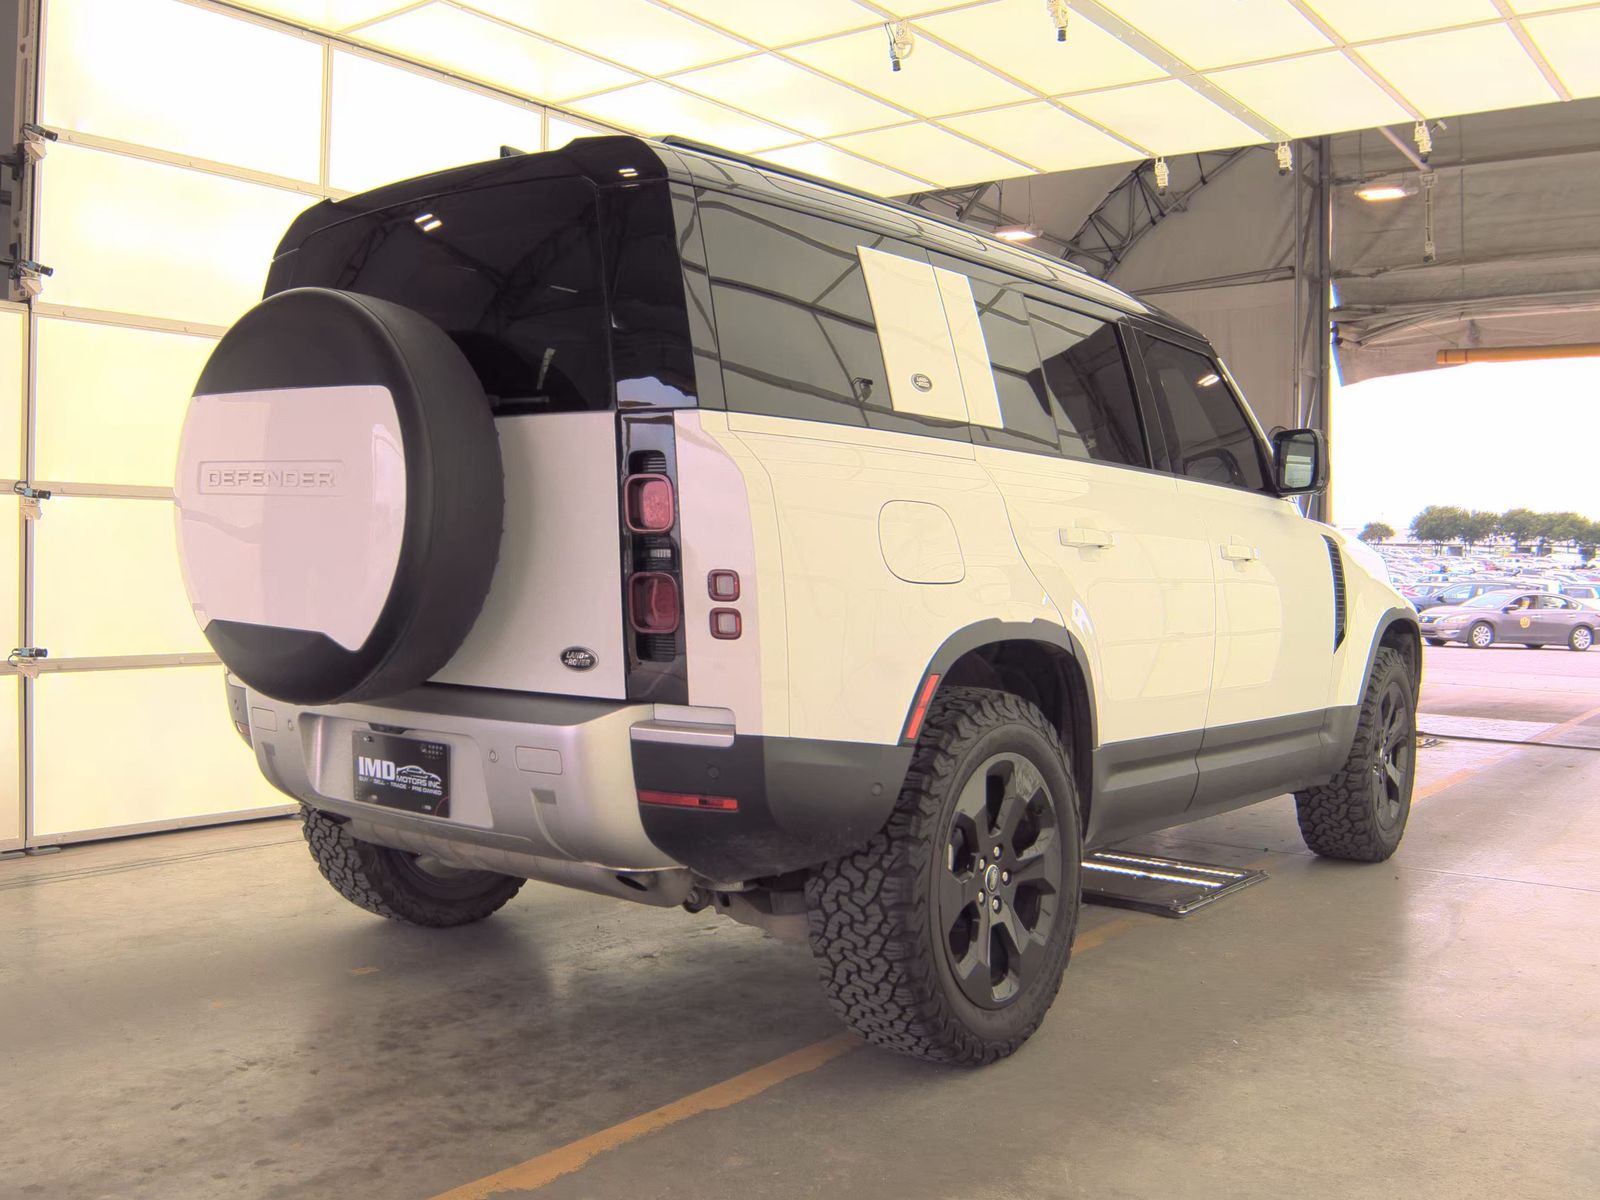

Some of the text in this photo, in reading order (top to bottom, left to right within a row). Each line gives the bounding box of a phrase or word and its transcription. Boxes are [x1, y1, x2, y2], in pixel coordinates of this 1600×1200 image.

[208, 469, 336, 488] DEFENDER
[358, 756, 396, 781] IMD
[396, 775, 427, 787] MOTORS
